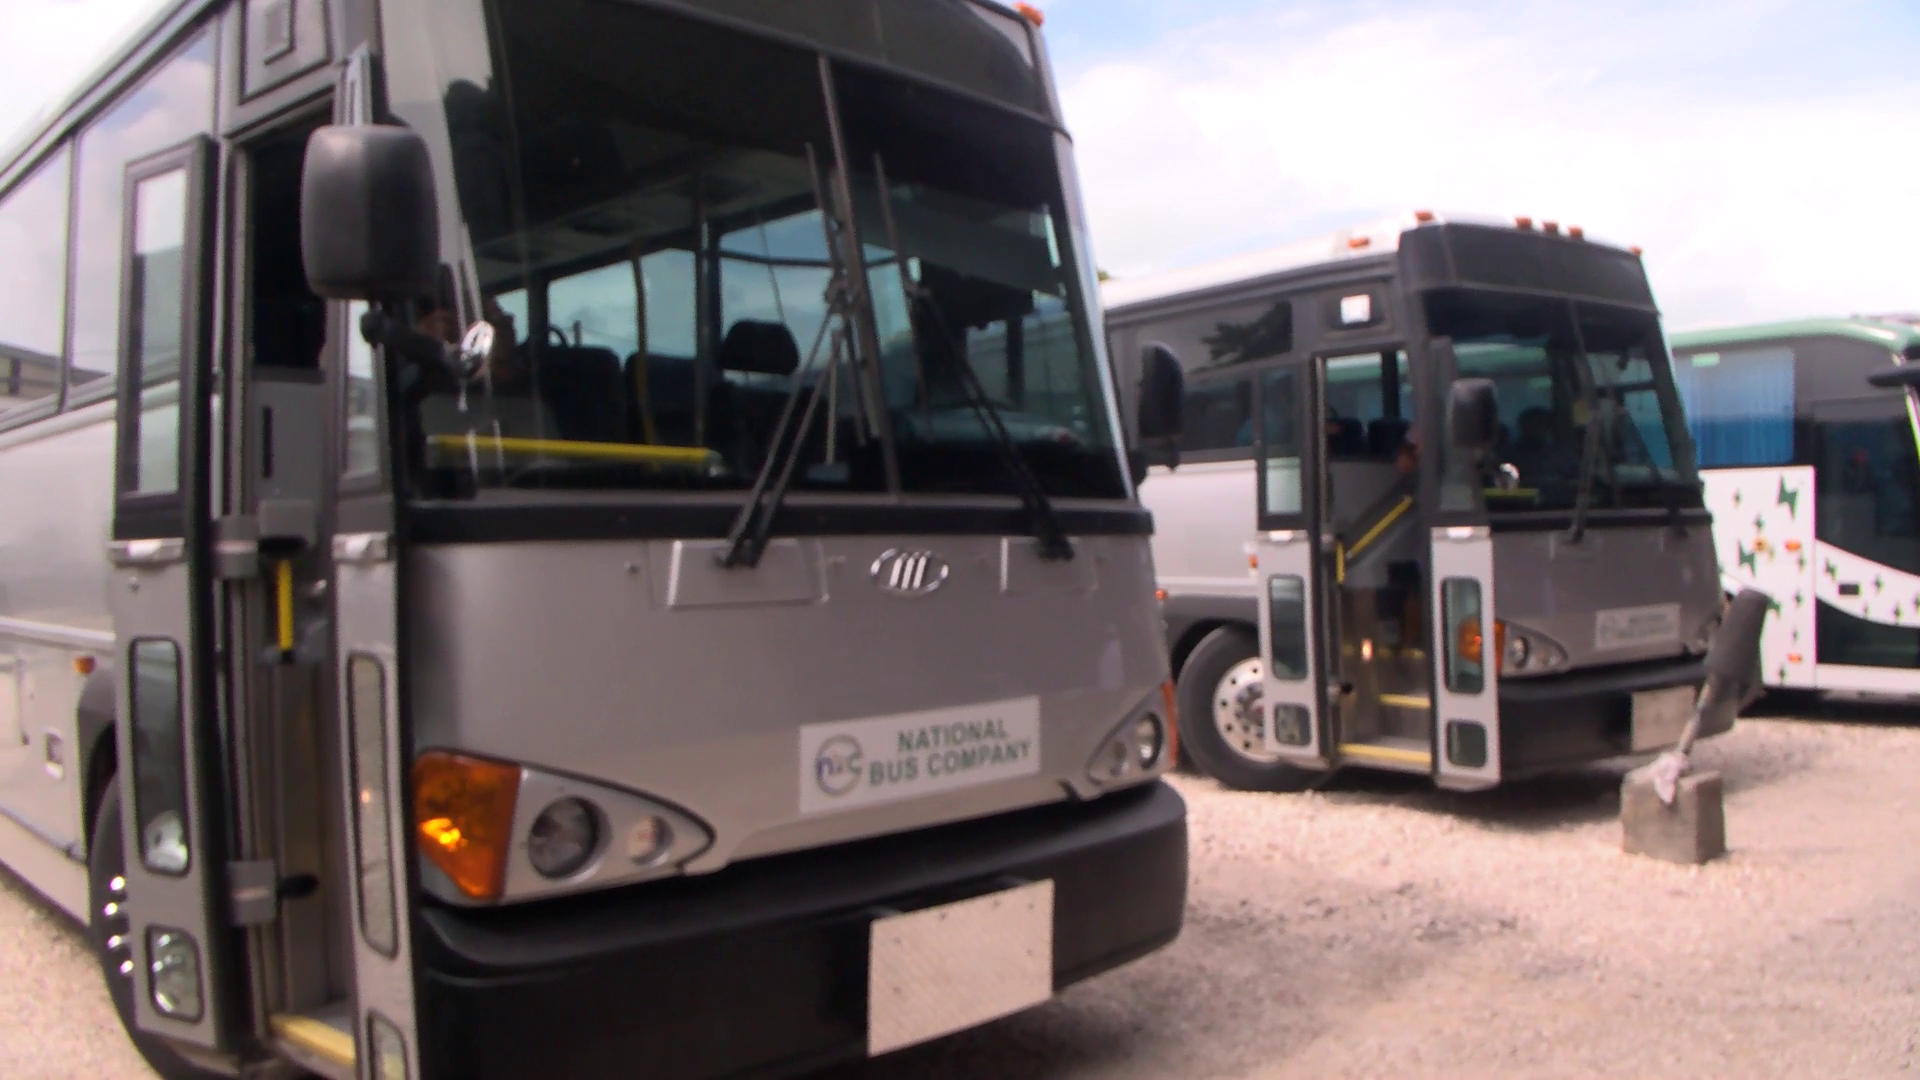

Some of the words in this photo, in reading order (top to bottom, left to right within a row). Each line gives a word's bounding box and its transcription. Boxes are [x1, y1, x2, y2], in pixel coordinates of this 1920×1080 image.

[898, 719, 1007, 751] NATIONAL
[869, 757, 919, 787] BUS
[927, 740, 1030, 776] COMPANY
